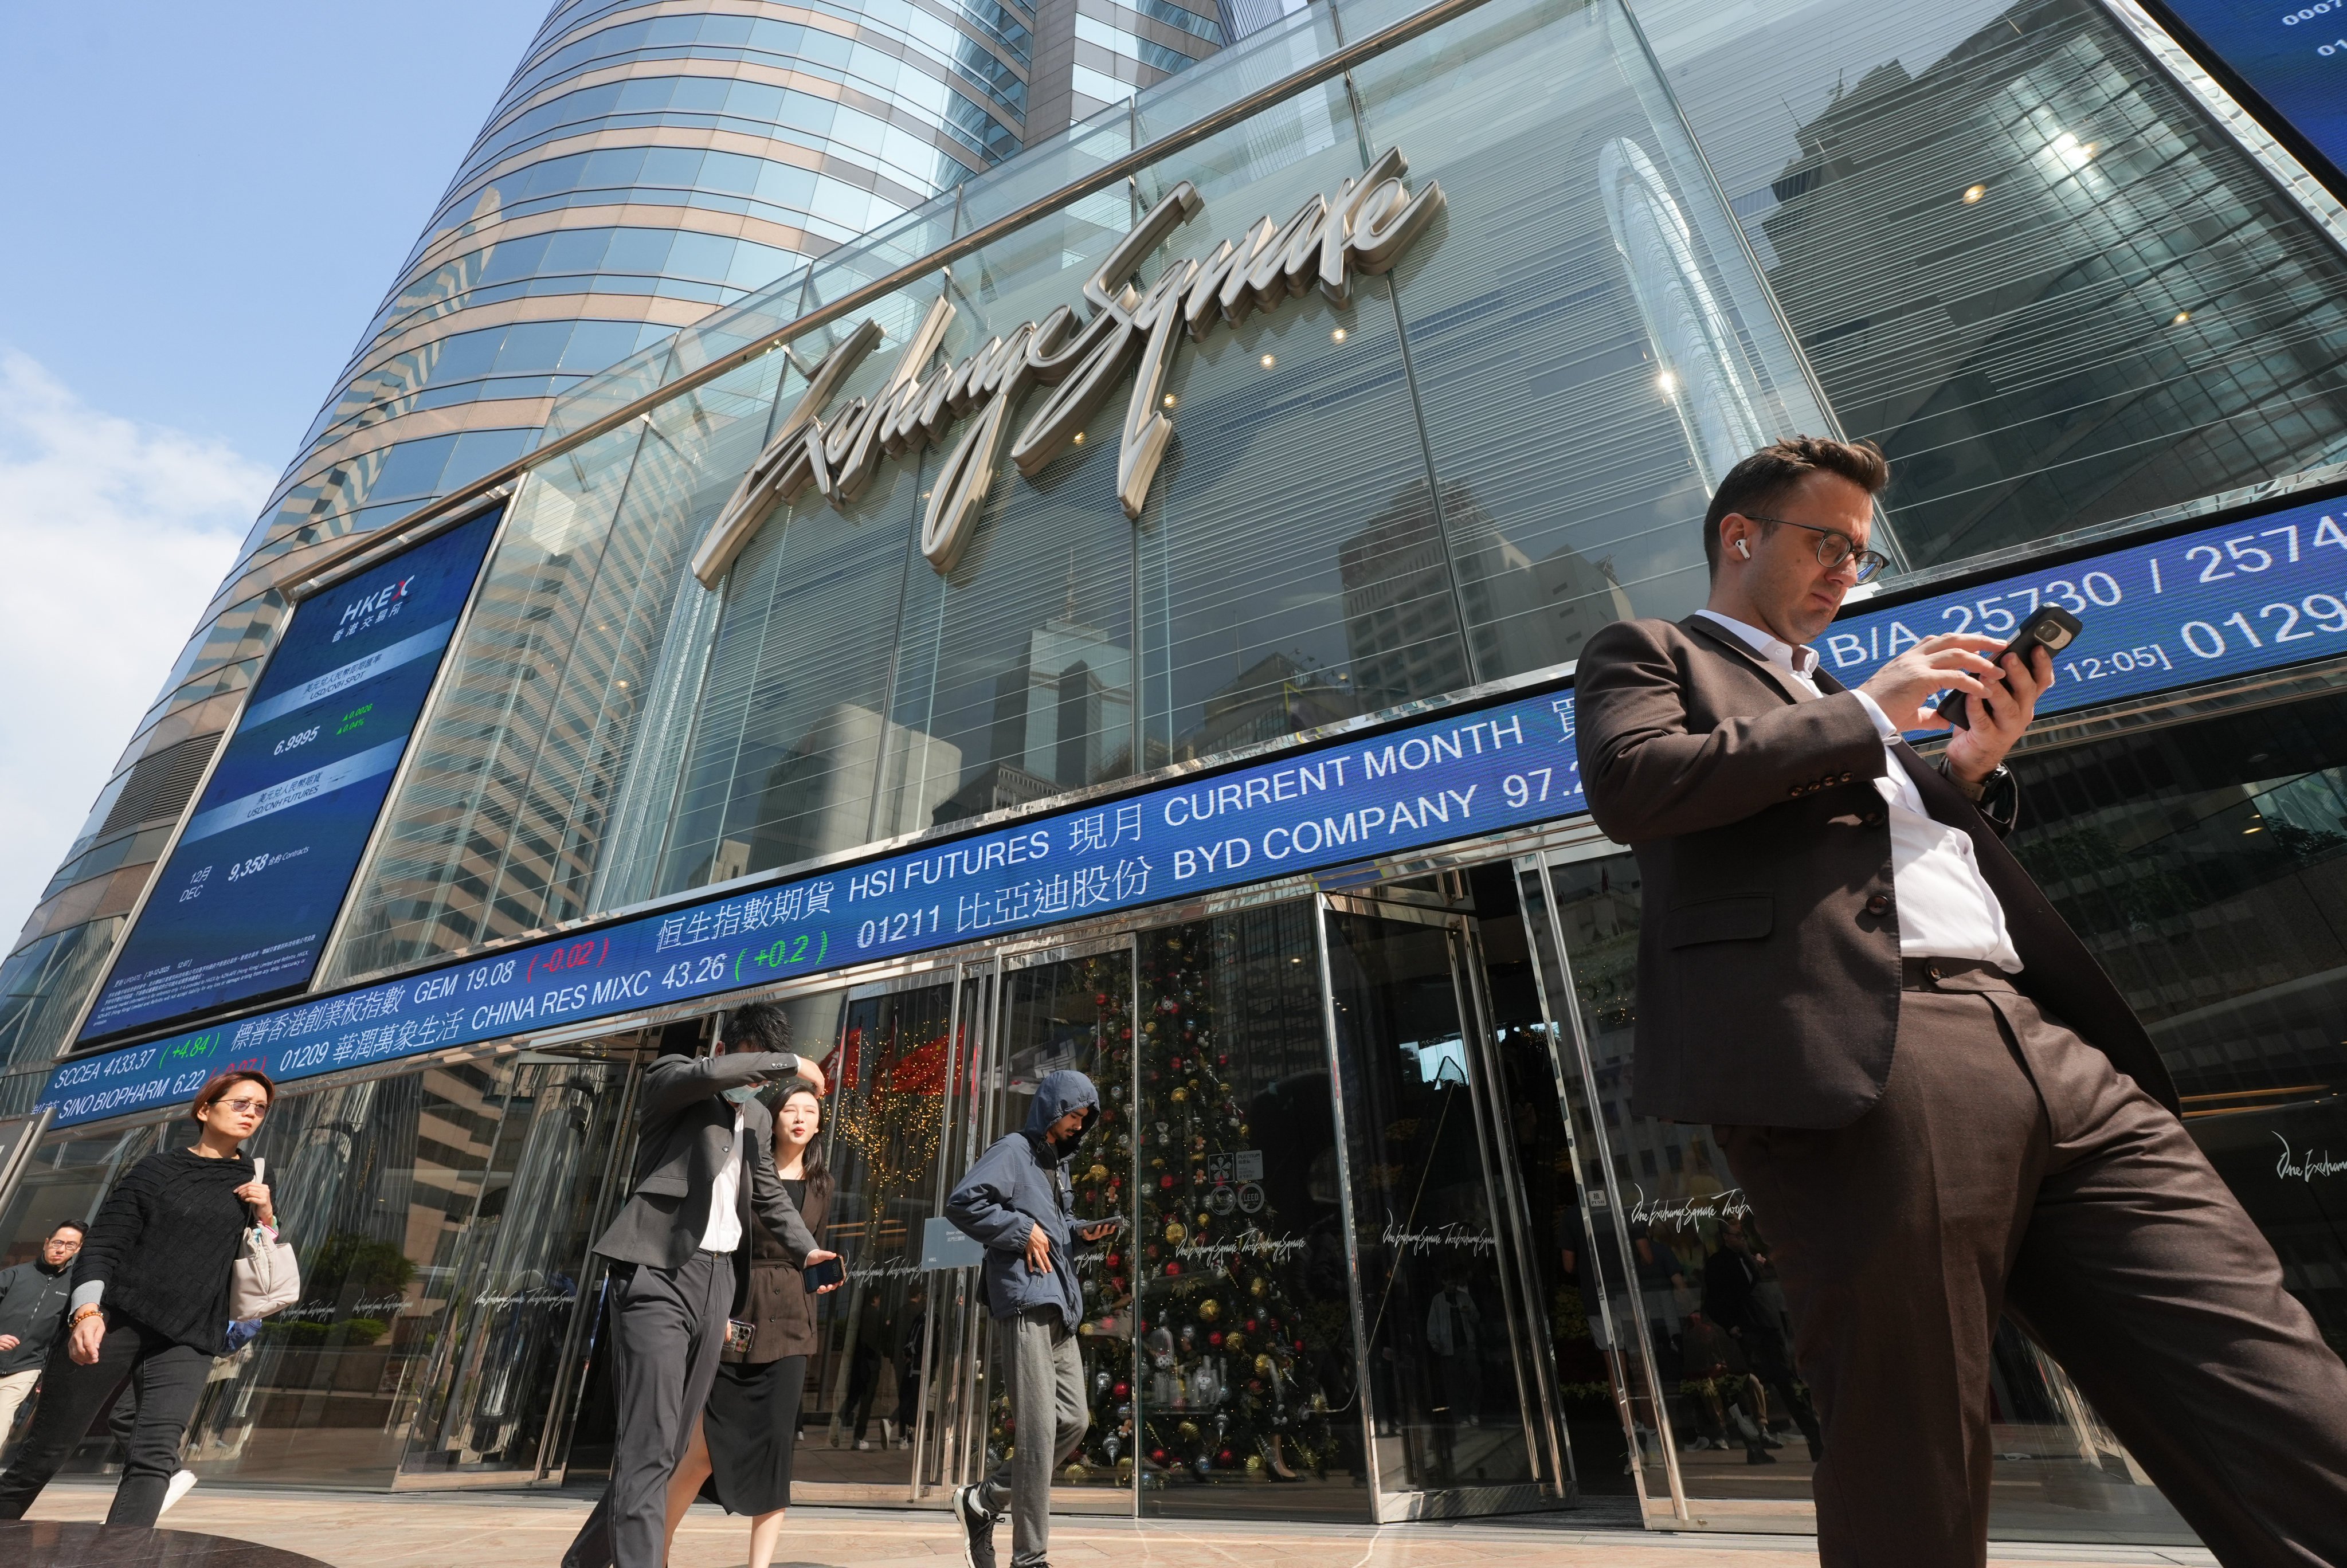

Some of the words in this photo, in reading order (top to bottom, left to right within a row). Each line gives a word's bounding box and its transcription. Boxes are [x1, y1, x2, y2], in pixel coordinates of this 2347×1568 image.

[339, 575, 415, 626] HKEX
[332, 602, 403, 643] 香港交易所
[344, 671, 366, 688] SPOT
[273, 725, 320, 756] 6.9995
[55, 1063, 101, 1088] SCCEA
[104, 1049, 156, 1077] 4133.37
[231, 985, 406, 1052] 標普香港創業板指數
[414, 974, 459, 1004] GEM
[466, 960, 516, 991] 19.08
[656, 881, 835, 952] 恒生指數期貨
[849, 868, 896, 902] HSI
[904, 831, 1049, 890] FUTURES
[1068, 803, 1143, 856] 現月
[1165, 756, 1350, 827] CURRENT
[1364, 715, 1523, 781] MONTH
[2184, 512, 2347, 583] 2574
[247, 799, 283, 818] USD/CNH
[283, 785, 320, 805] FUTURES
[92, 1077, 171, 1113] BIOPHARM
[172, 1068, 206, 1095] 6.22
[280, 1041, 330, 1072] 01209
[332, 1009, 467, 1065] 華潤萬象生活
[471, 996, 535, 1031] CHINA
[540, 984, 587, 1017] RES
[591, 970, 652, 1006] MIXC
[661, 952, 728, 991] 43.26
[857, 904, 939, 950] 01211
[955, 856, 1153, 934] 比亞迪股份
[1174, 838, 1251, 880] BYD
[1263, 785, 1478, 860] COMPANY
[2181, 593, 2347, 660] 0129
[228, 853, 269, 883] 9,358
[282, 846, 311, 861] Contracts
[190, 865, 213, 884] 12月
[179, 885, 203, 903] DEC
[2271, 1130, 2303, 1179] One
[1244, 1193, 1259, 1202] LEED
[1631, 1182, 1649, 1224] One
[1383, 1208, 1396, 1244] One
